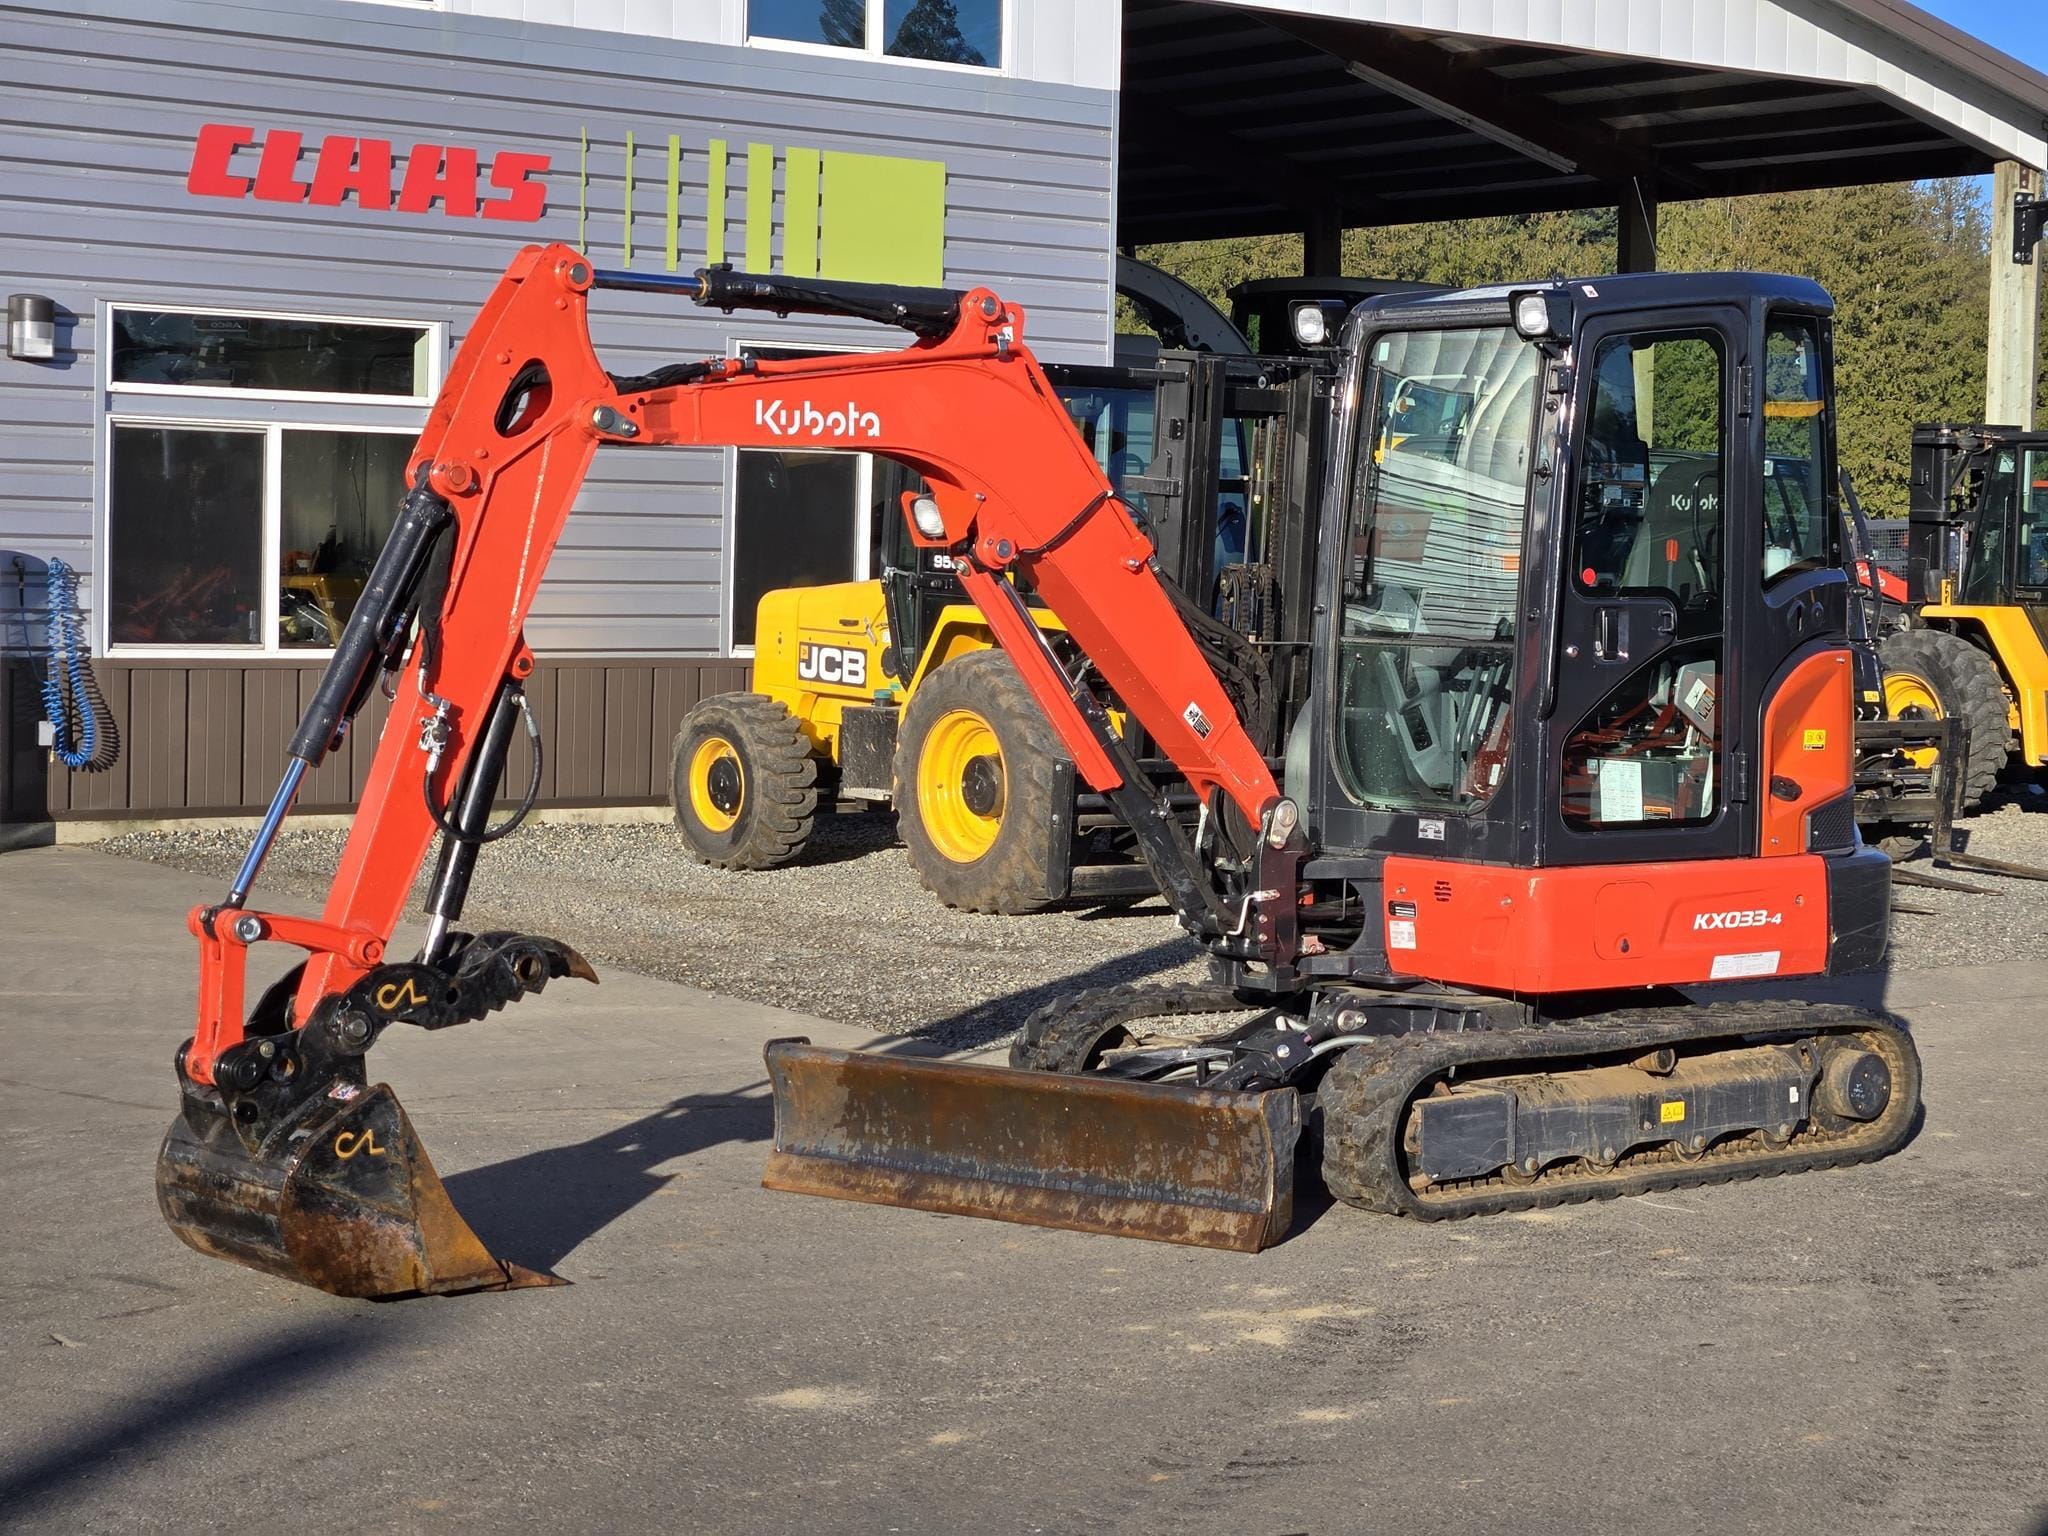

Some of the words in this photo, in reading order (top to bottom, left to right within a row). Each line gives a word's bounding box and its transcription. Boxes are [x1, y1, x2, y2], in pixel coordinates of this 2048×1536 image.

[187, 123, 552, 223] CLAAS
[755, 399, 881, 437] Kubota
[933, 554, 957, 570] 95
[799, 645, 866, 685] JCB
[1692, 909, 1783, 930] KX033-4
